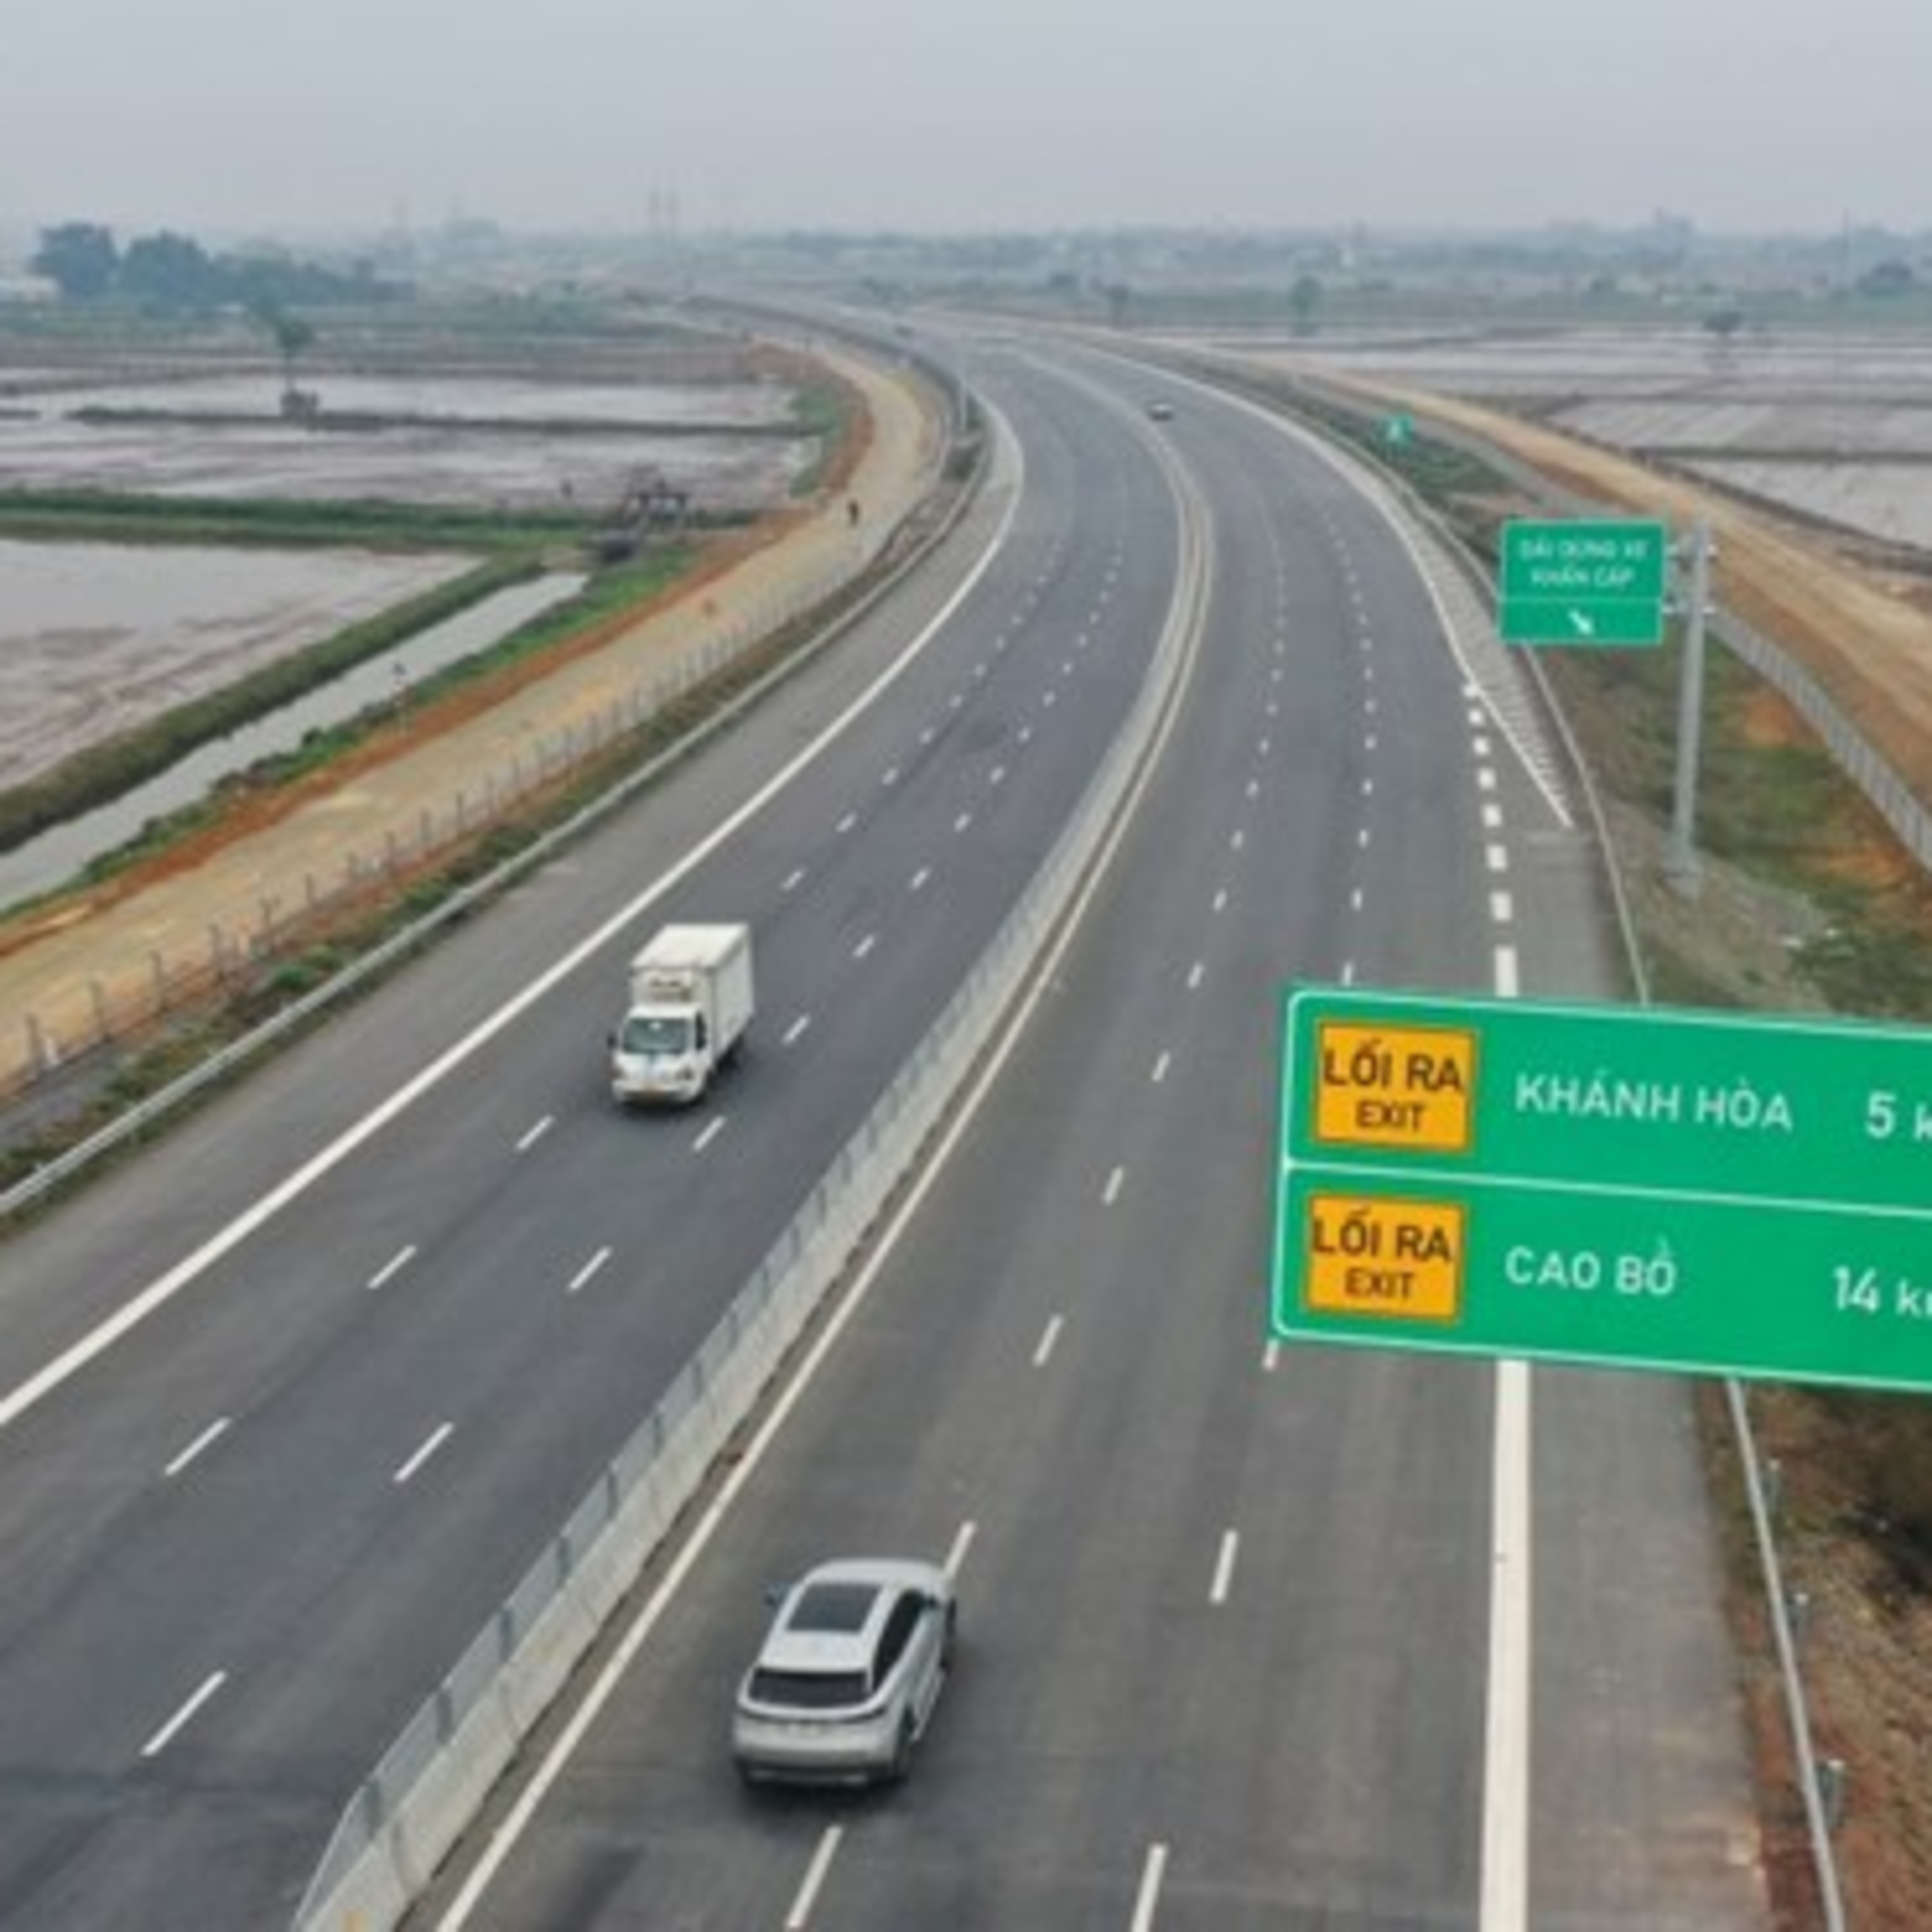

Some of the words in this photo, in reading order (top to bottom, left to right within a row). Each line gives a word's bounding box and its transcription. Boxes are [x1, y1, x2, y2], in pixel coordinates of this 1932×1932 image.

[1322, 1037, 1392, 1088] LỐI
[1406, 1053, 1463, 1092] RA
[1356, 1100, 1426, 1132] EXIT
[1515, 1068, 1680, 1123] KHÁNH
[1694, 1074, 1794, 1133] HÒA
[1866, 1090, 1897, 1139] 5
[1913, 1103, 1932, 1140] k
[1311, 1206, 1381, 1258] LỐI
[1396, 1224, 1452, 1263] RA
[1344, 1267, 1414, 1300] EXIT
[1505, 1244, 1602, 1290] CAO
[1833, 1265, 1880, 1312] 14
